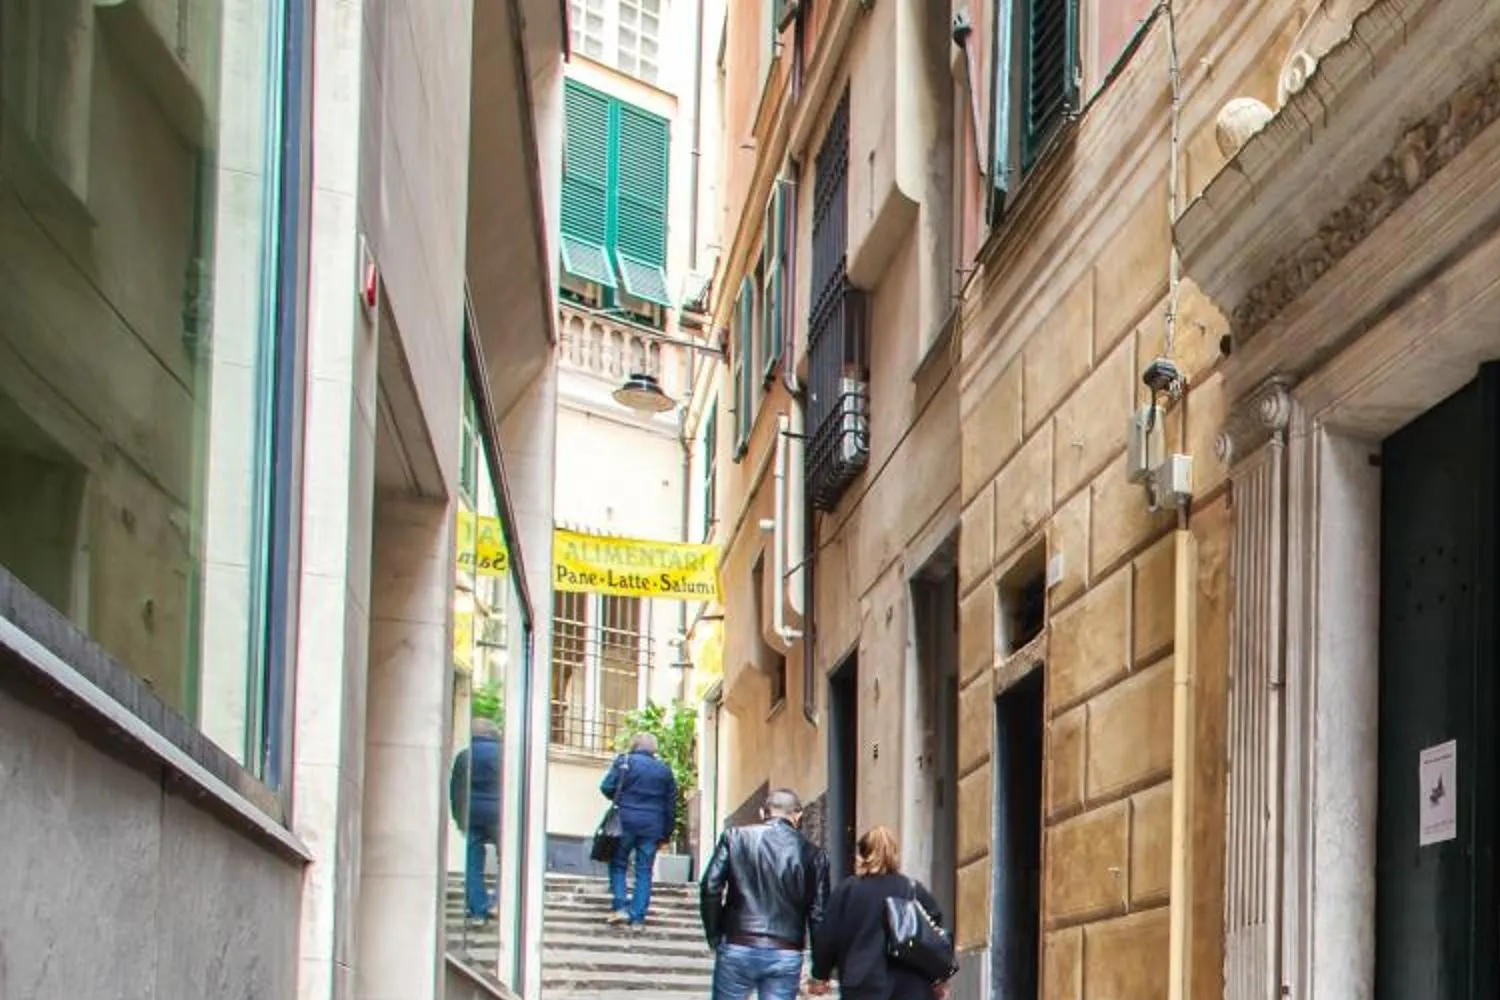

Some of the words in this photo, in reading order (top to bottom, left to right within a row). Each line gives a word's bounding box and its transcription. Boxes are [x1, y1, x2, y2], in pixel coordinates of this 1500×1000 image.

[565, 541, 706, 571] ALIMENTARI
[556, 563, 599, 586] Pane
[607, 568, 650, 591] Latte
[660, 573, 715, 595] Salumi
